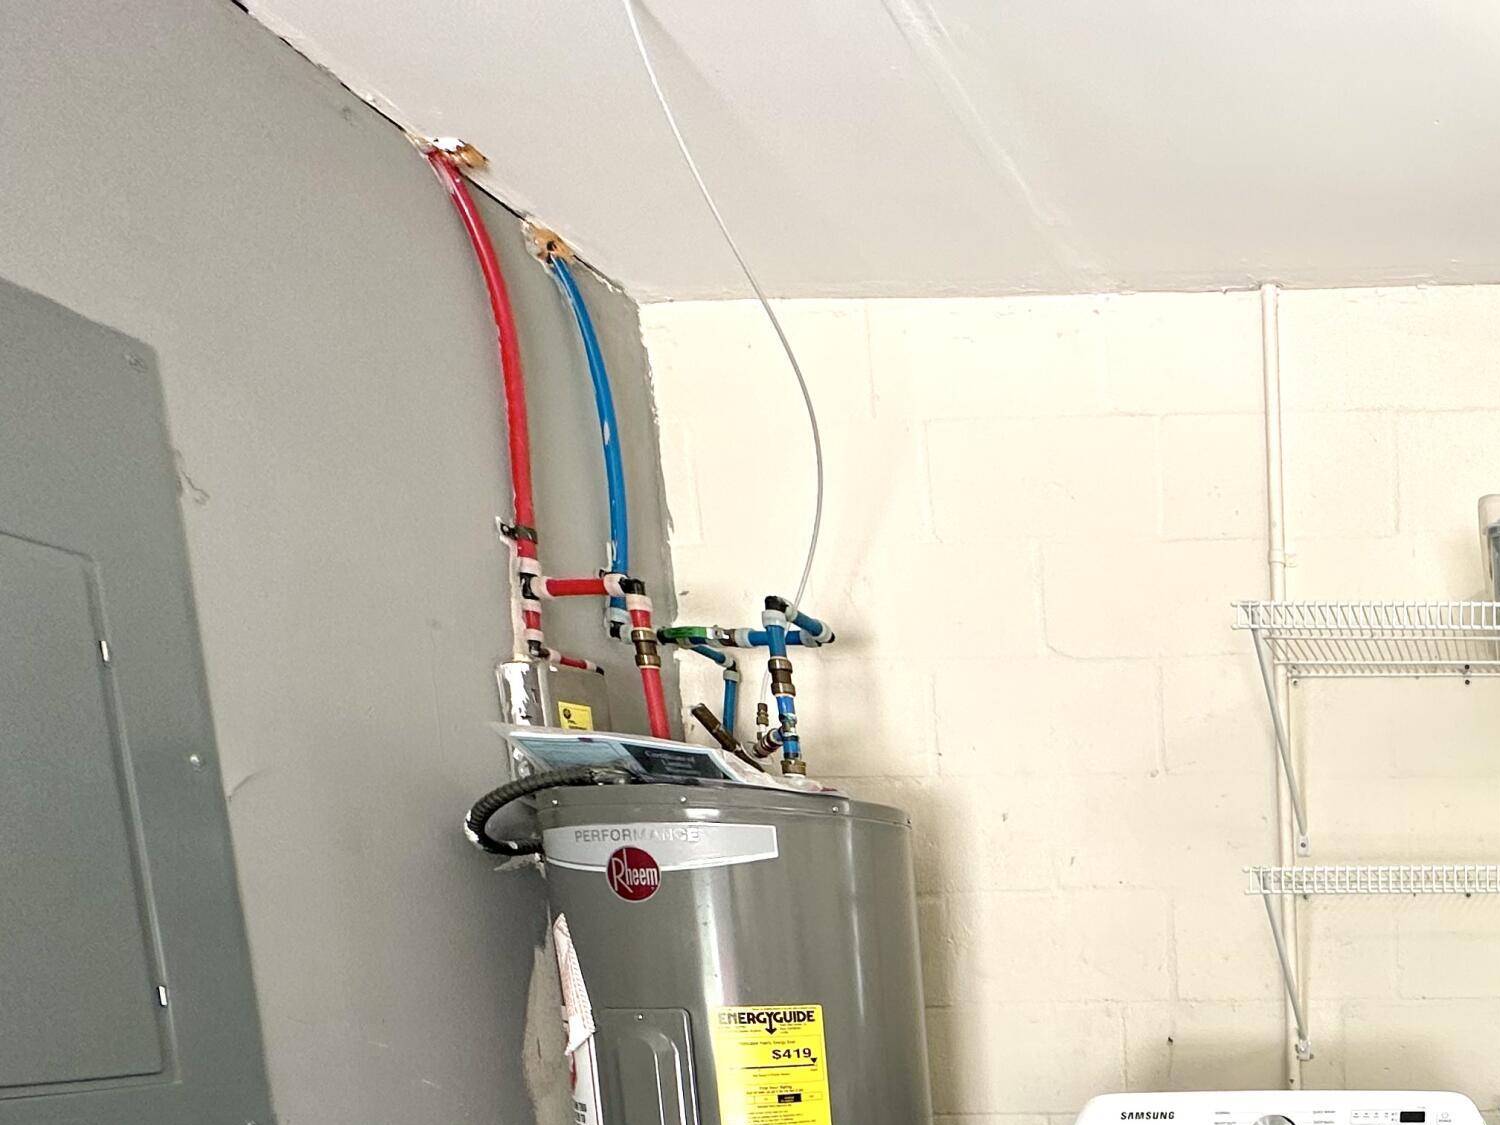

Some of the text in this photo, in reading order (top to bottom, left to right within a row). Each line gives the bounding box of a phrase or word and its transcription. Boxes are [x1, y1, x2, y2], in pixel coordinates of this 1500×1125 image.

[574, 827, 701, 843] PERFORMANCE
[611, 848, 659, 893] Rheem
[718, 1010, 816, 1026] ENERGYGUIDE
[1120, 1111, 1175, 1120] SAMSUNG
